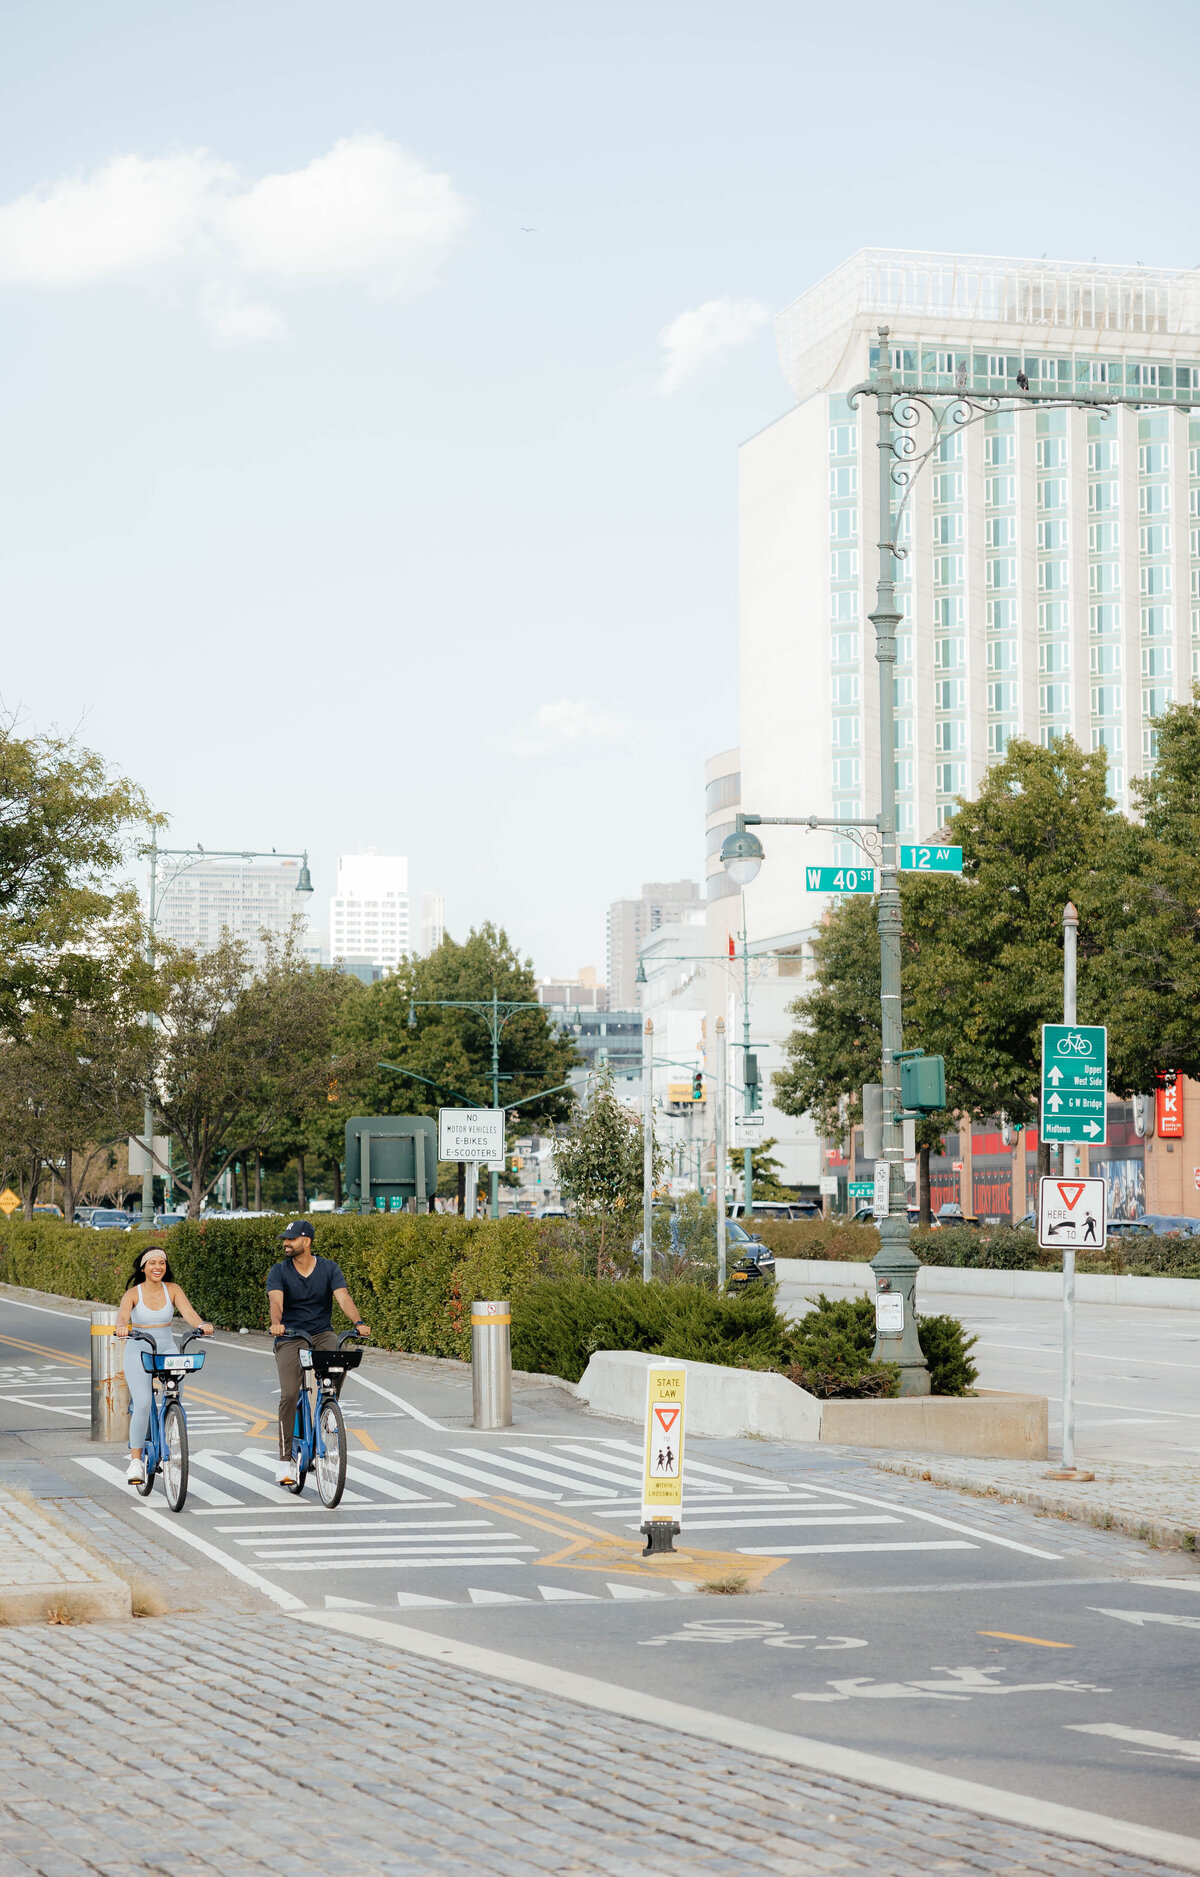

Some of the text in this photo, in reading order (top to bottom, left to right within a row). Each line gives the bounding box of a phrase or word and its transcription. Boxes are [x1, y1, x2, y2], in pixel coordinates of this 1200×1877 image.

[910, 848, 950, 869] 12 AV
[808, 869, 872, 890] W 40 ST
[1084, 1065, 1103, 1075] Upper
[1073, 1076, 1103, 1087] West Side
[1068, 1098, 1103, 1110] G W Bridge
[469, 1126, 497, 1134] VEHICLES
[1046, 1123, 1071, 1134] Midtown
[446, 1149, 497, 1157] E-SCOOTERS
[974, 1181, 1011, 1215] LUCKY STRIKE
[1048, 1210, 1067, 1219] HERE
[1066, 1230, 1077, 1239] TO
[656, 1378, 680, 1387] STATE
[659, 1390, 677, 1398] LAW
